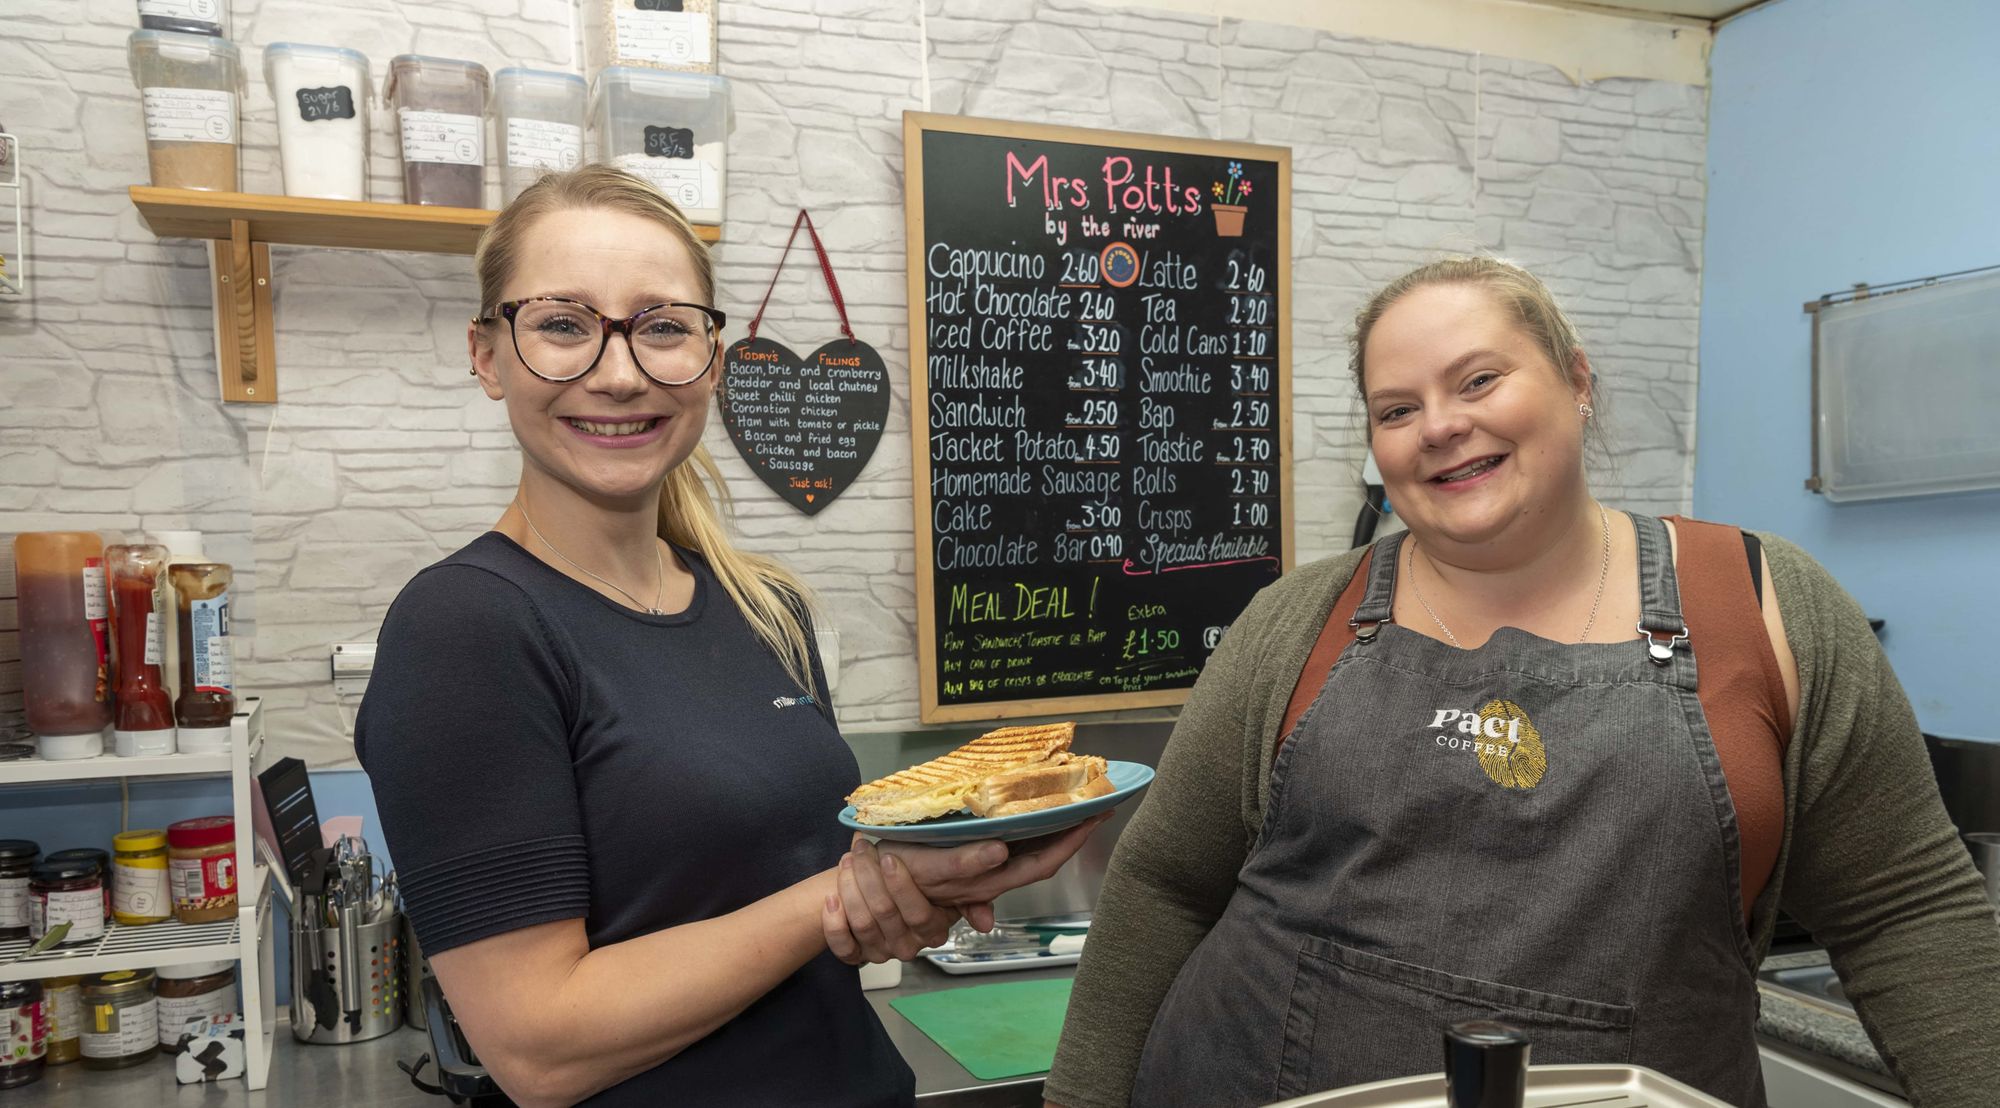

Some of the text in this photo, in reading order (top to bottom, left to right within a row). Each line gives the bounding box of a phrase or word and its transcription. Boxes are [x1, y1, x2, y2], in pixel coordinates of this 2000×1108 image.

[1007, 151, 1201, 215] Mrs Potts
[1045, 212, 1160, 246] by the river
[928, 241, 1045, 289] Cappucino
[1138, 250, 1197, 290] Latte
[927, 281, 966, 315] Hot
[975, 284, 1071, 319] Chocolate
[1141, 293, 1176, 323] Tea
[929, 317, 972, 349] Iced
[981, 318, 1053, 351] Coffee
[1140, 324, 1179, 354] Cold
[1187, 325, 1228, 355] Cans
[768, 363, 792, 375] brie
[800, 365, 821, 377] and
[827, 367, 882, 381] cranberry
[818, 352, 861, 367] FILLINGS
[928, 354, 1024, 389] Milkshake
[1139, 356, 1212, 393] Smoothie
[727, 376, 878, 393] Cheddar and local chutney
[728, 388, 841, 404] Sweet chilli chicken
[731, 401, 838, 417] Coronation chicken
[738, 415, 880, 432] Ham with tomato or pickle
[930, 392, 1026, 428] Sandwich
[1138, 397, 1175, 439] Bap
[744, 430, 856, 447] Bacon and fried egg
[755, 443, 857, 459] Chicken and bacon
[930, 431, 1005, 462] Jacket
[1014, 430, 1076, 462] Potato
[1136, 432, 1203, 463] Toastie
[769, 458, 814, 471] Sausage
[789, 477, 833, 489] Just ask!
[931, 466, 1032, 497] Homemade
[1041, 464, 1121, 506] Sausage
[1133, 466, 1177, 496] Rolls
[934, 500, 992, 534] Cake
[1138, 500, 1192, 538] Crisps
[937, 534, 1038, 571] Chocolate
[1053, 533, 1087, 563] Bar
[1140, 532, 1269, 575] Specials Available
[949, 582, 1007, 626] MEAL
[1013, 582, 1075, 621] DEAL
[1127, 604, 1167, 621] Extra
[1144, 673, 1163, 686] your
[1426, 708, 1521, 743] Pact
[1435, 735, 1508, 757] COFFEE
